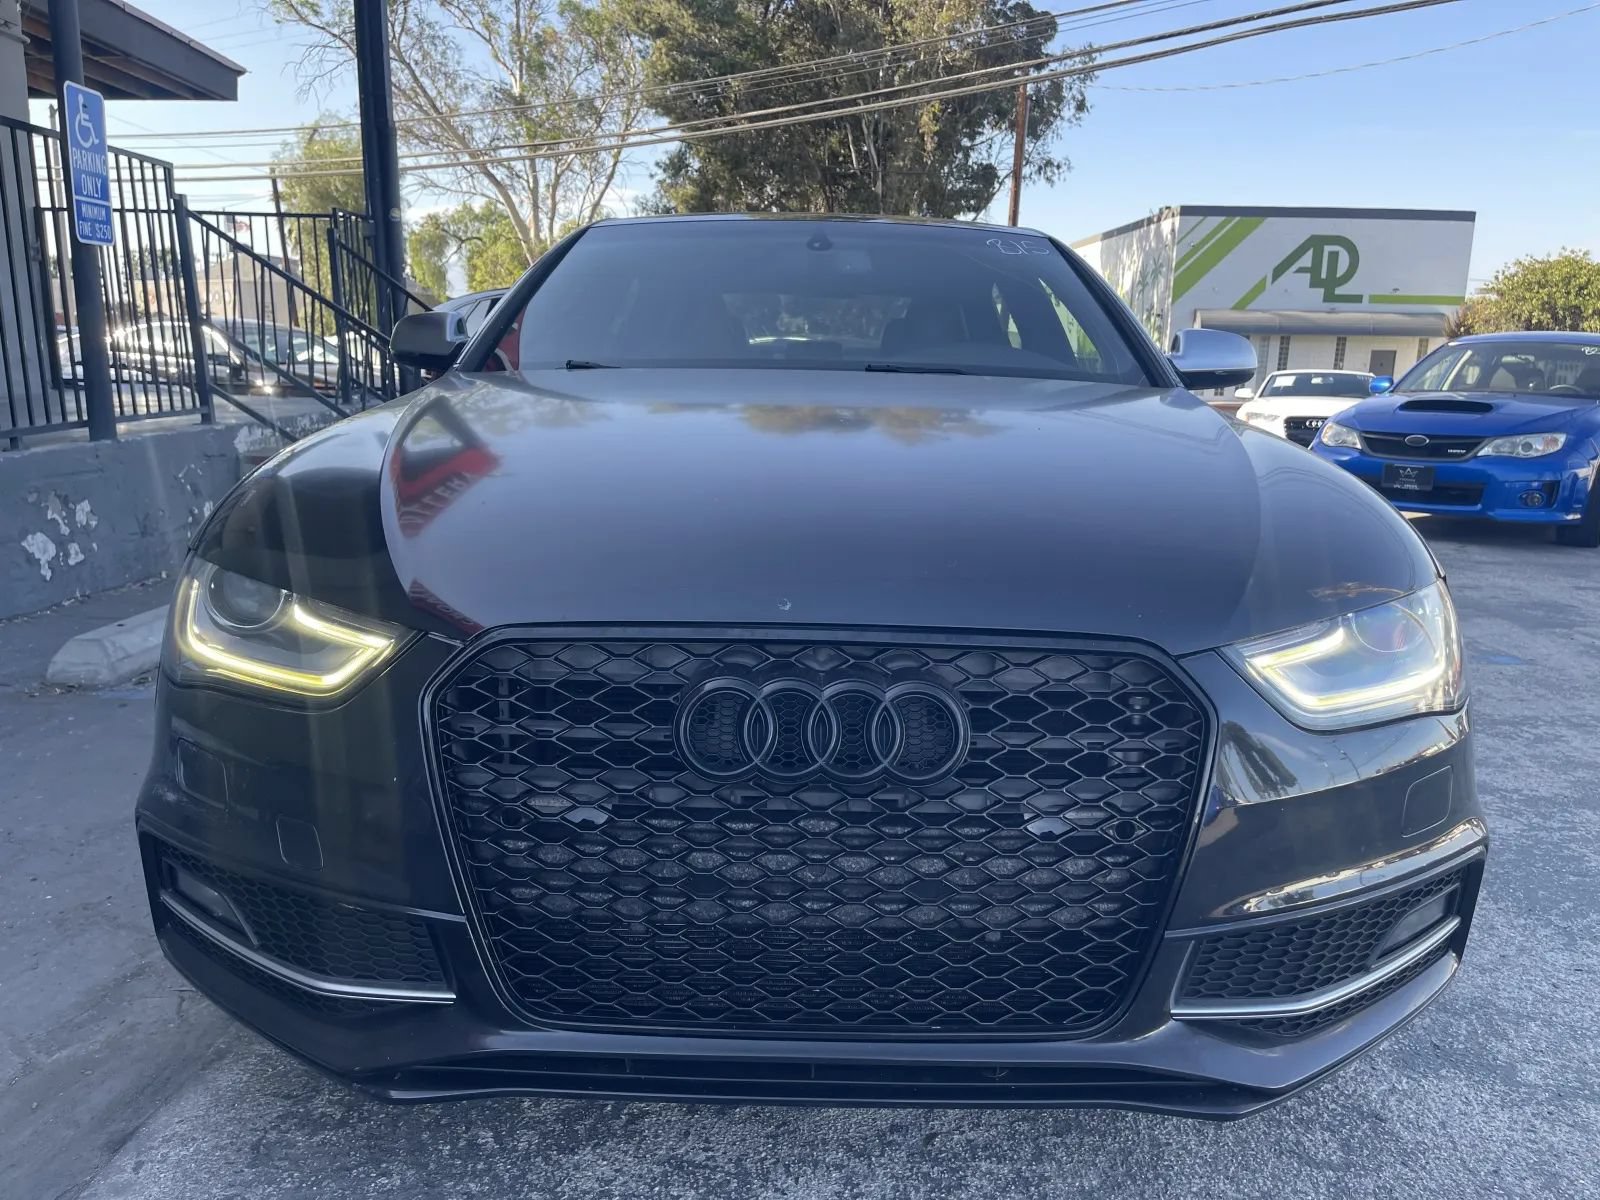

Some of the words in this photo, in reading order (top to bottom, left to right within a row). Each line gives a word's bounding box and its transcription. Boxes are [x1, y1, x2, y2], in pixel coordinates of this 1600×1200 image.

[72, 148, 107, 175] PARKING
[81, 175, 102, 198] ONLY
[81, 203, 106, 221] MINIMUM
[79, 220, 92, 237] FINE
